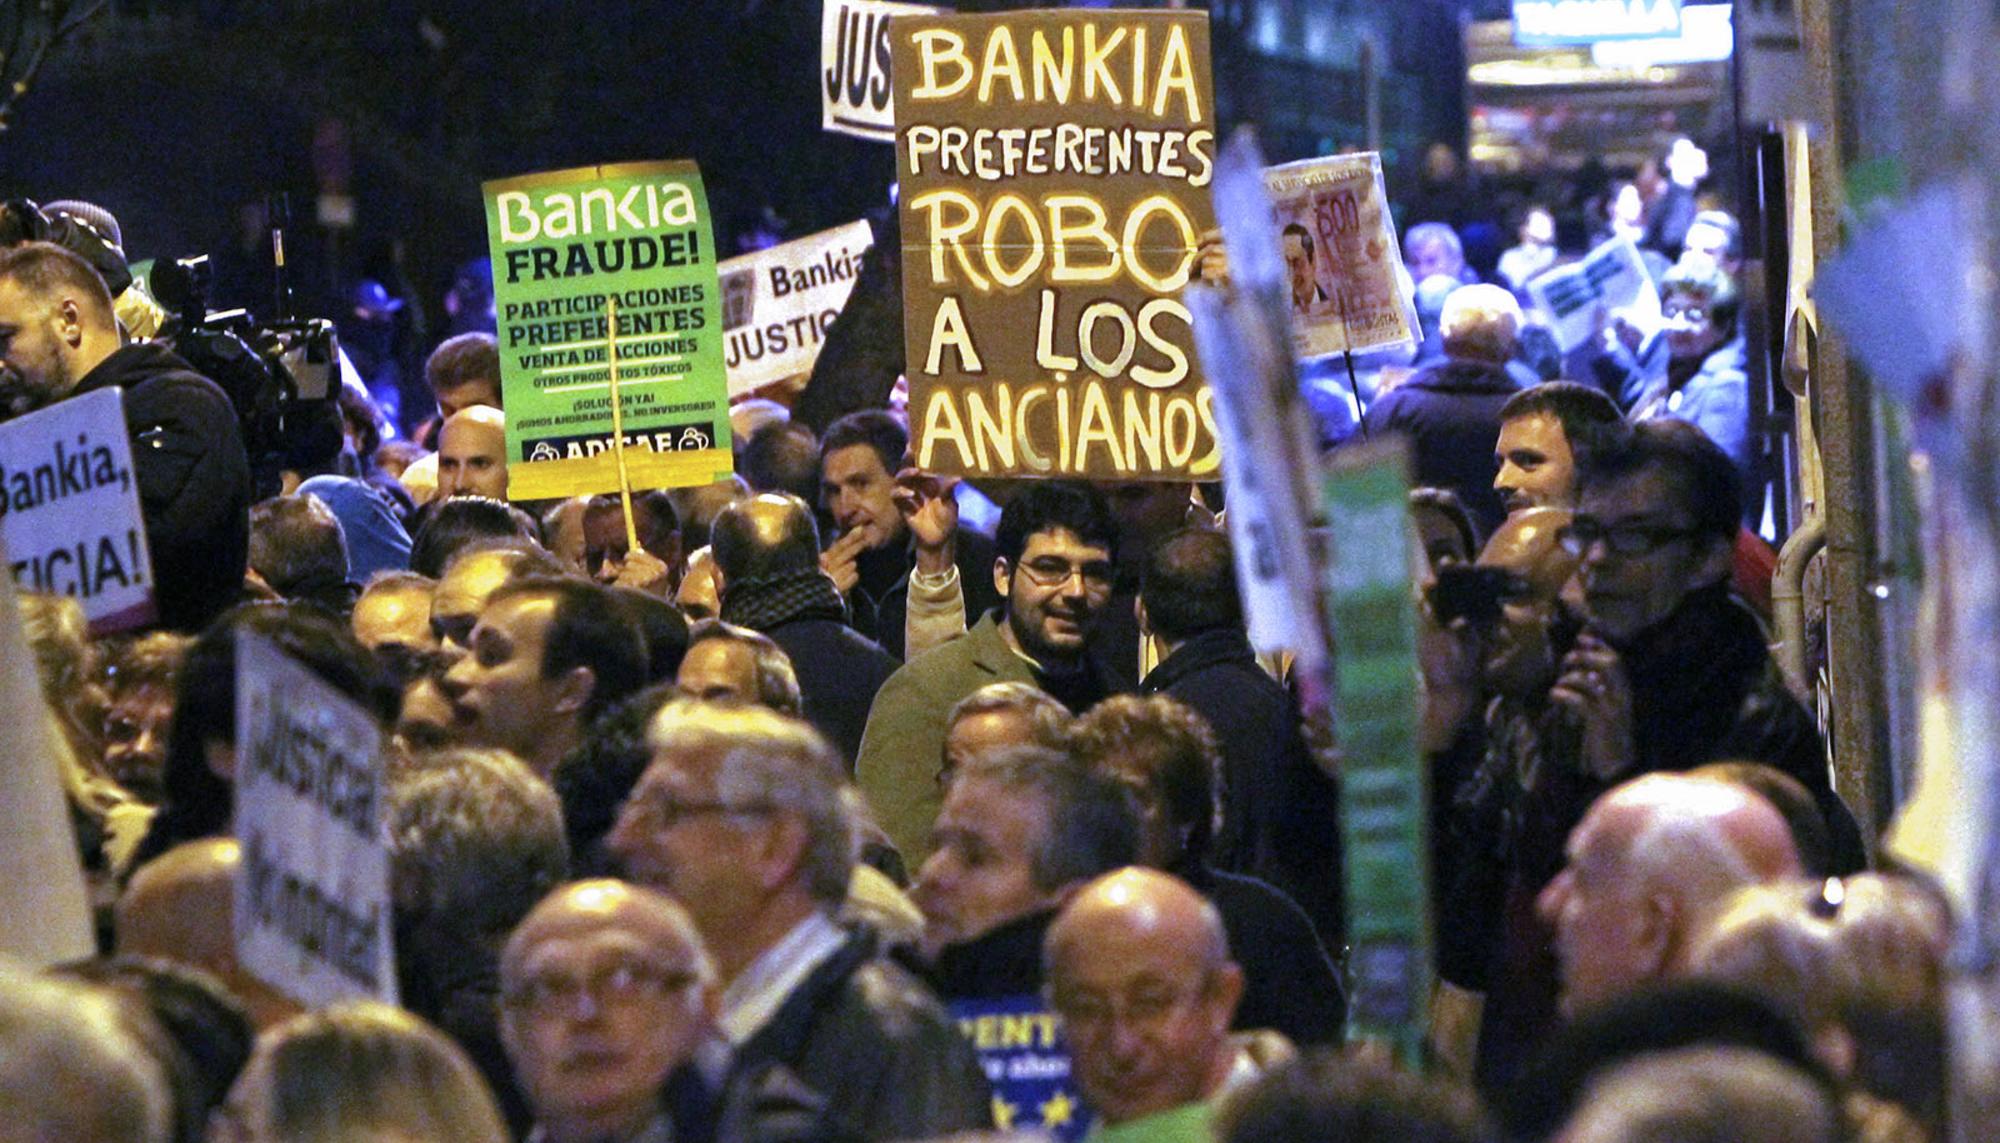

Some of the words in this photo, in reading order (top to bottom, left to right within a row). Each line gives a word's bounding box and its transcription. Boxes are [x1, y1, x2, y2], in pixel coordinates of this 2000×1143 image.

[911, 23, 1202, 123] BANKIA
[906, 123, 1213, 187] PREFERENTES
[497, 182, 697, 243] Bankia
[910, 191, 1199, 293] ROBO
[505, 230, 700, 283] FRAUDE!
[505, 284, 704, 321] PARTICIPACIONES
[519, 349, 580, 370] VENTA
[584, 347, 606, 364] DE
[923, 297, 983, 376] A
[1036, 289, 1194, 388] LOS
